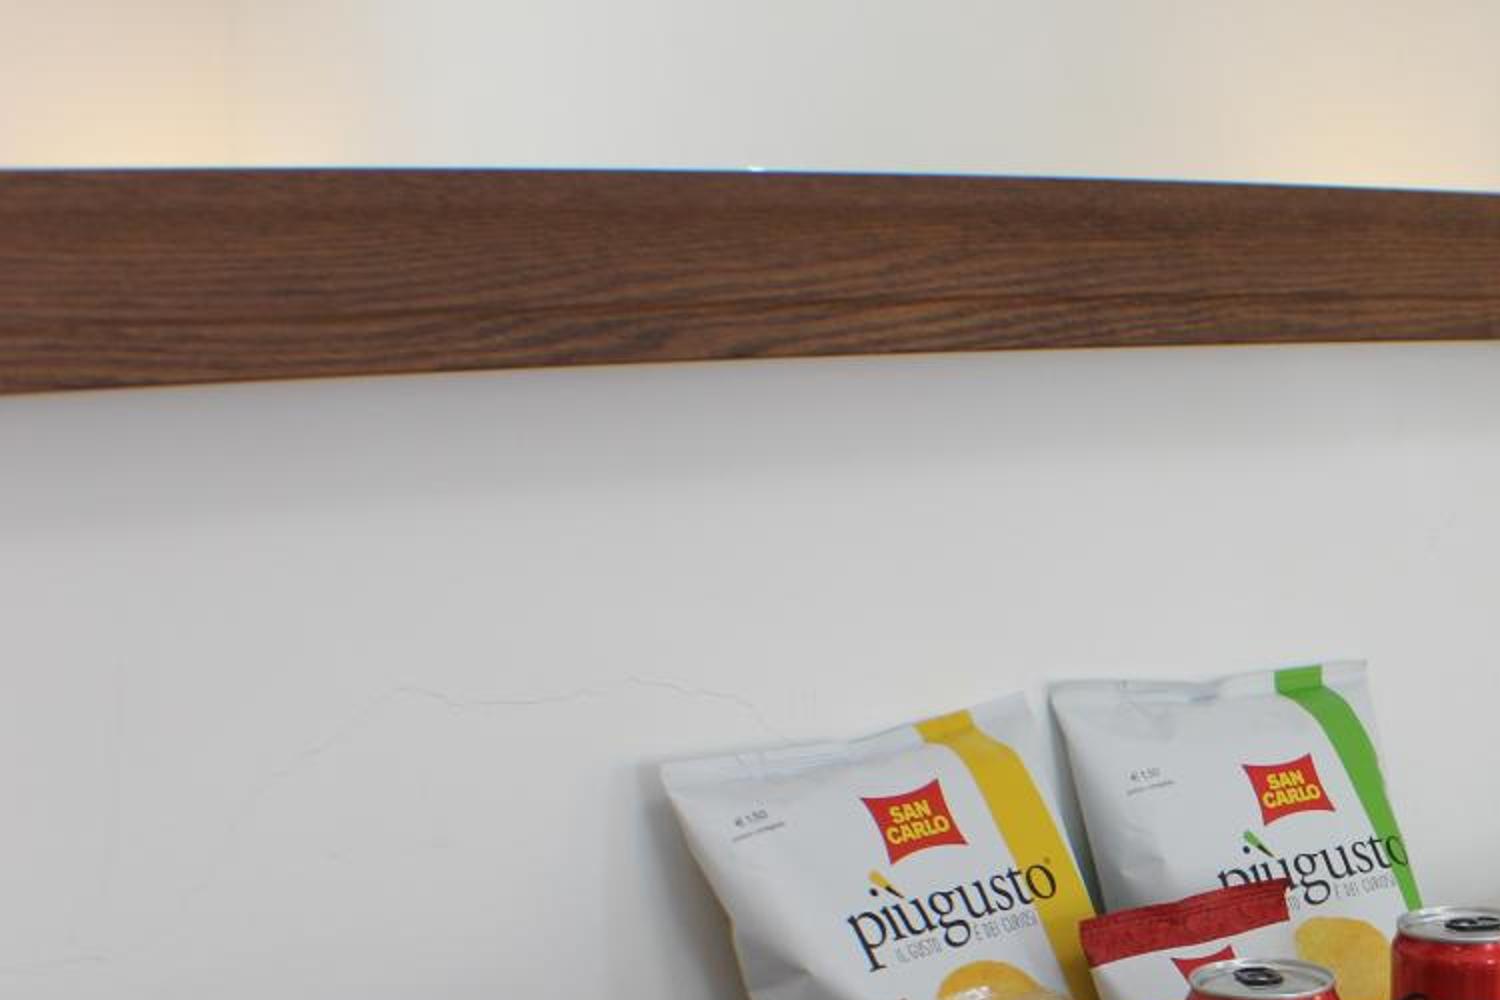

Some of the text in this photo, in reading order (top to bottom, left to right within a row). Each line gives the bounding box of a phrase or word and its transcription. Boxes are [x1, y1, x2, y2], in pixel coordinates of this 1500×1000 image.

[1266, 770, 1304, 790] SAN
[1263, 784, 1321, 808] CARLO
[889, 800, 932, 823] SAN
[886, 815, 949, 845] CARLO
[848, 864, 1057, 973] piùgusto
